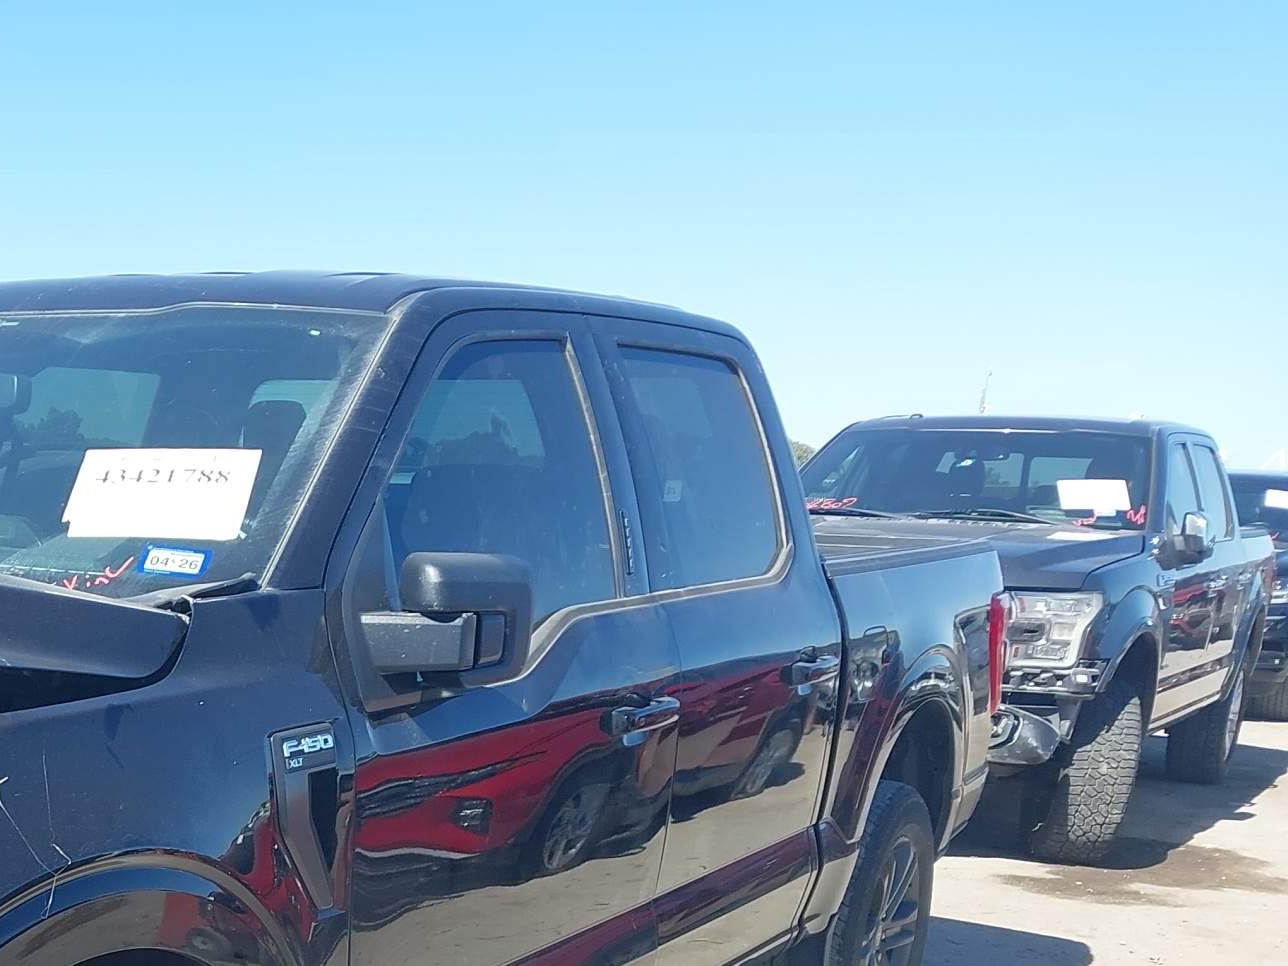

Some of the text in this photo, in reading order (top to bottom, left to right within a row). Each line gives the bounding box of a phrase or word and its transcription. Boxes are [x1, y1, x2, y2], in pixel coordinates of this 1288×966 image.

[96, 467, 231, 484] 43421788
[150, 556, 200, 570] 04 26
[282, 734, 334, 757] F-150
[289, 758, 304, 769] XLT
